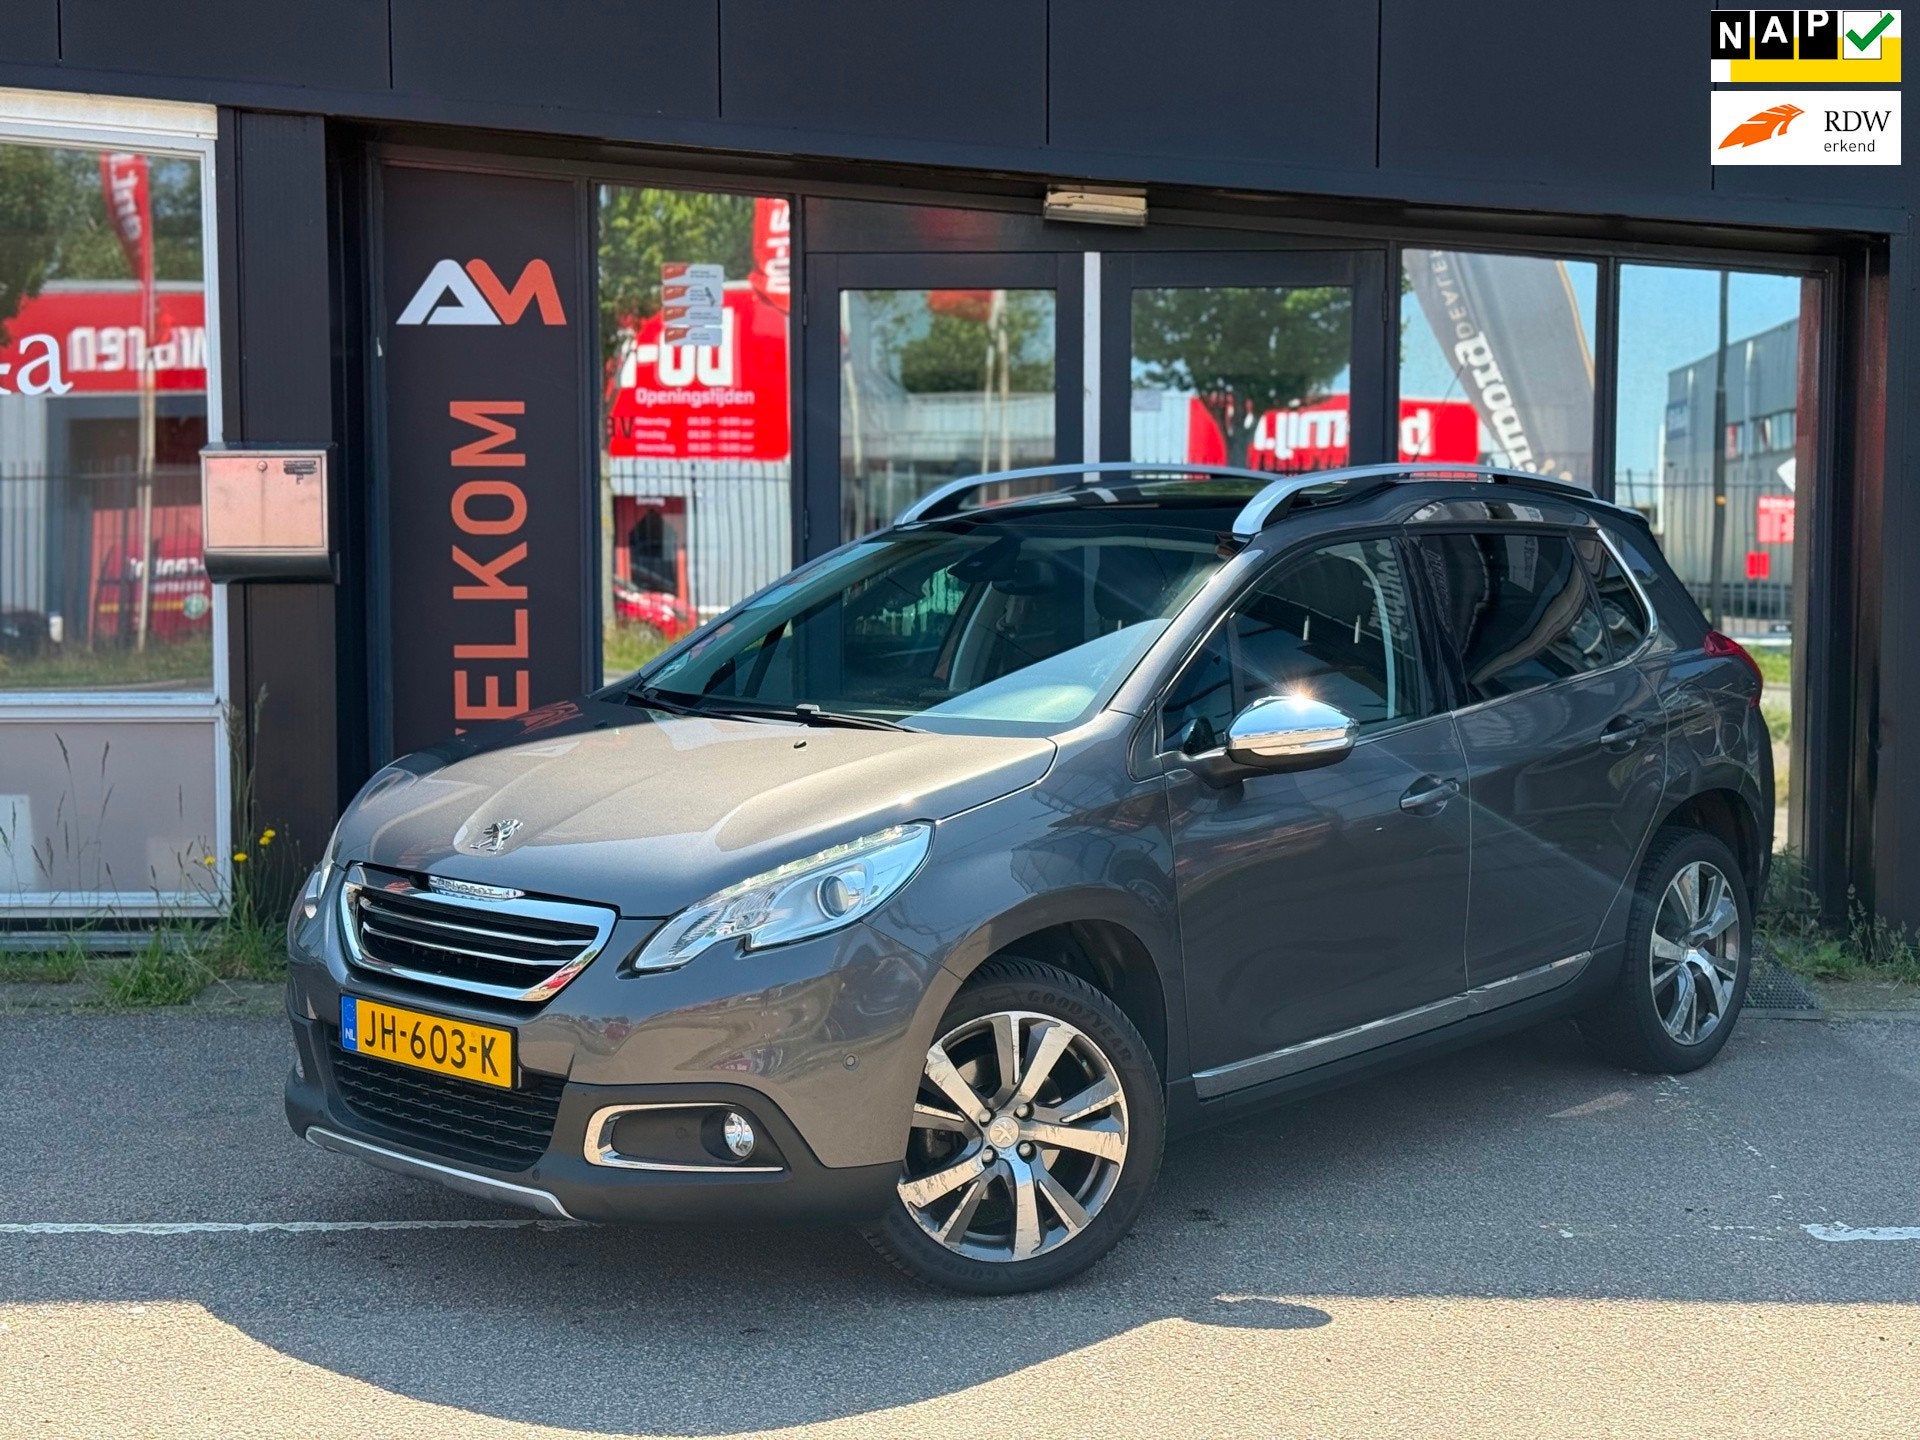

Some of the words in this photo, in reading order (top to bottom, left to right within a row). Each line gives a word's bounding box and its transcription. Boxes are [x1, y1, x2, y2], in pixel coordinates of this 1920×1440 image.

[0, 333, 74, 396] a
[634, 387, 756, 409] Openingstijden
[449, 400, 530, 736] ELKOM
[344, 1027, 357, 1042] NL
[364, 1009, 499, 1078] JH-603-K
[1027, 990, 1133, 1061] GOODYEAR
